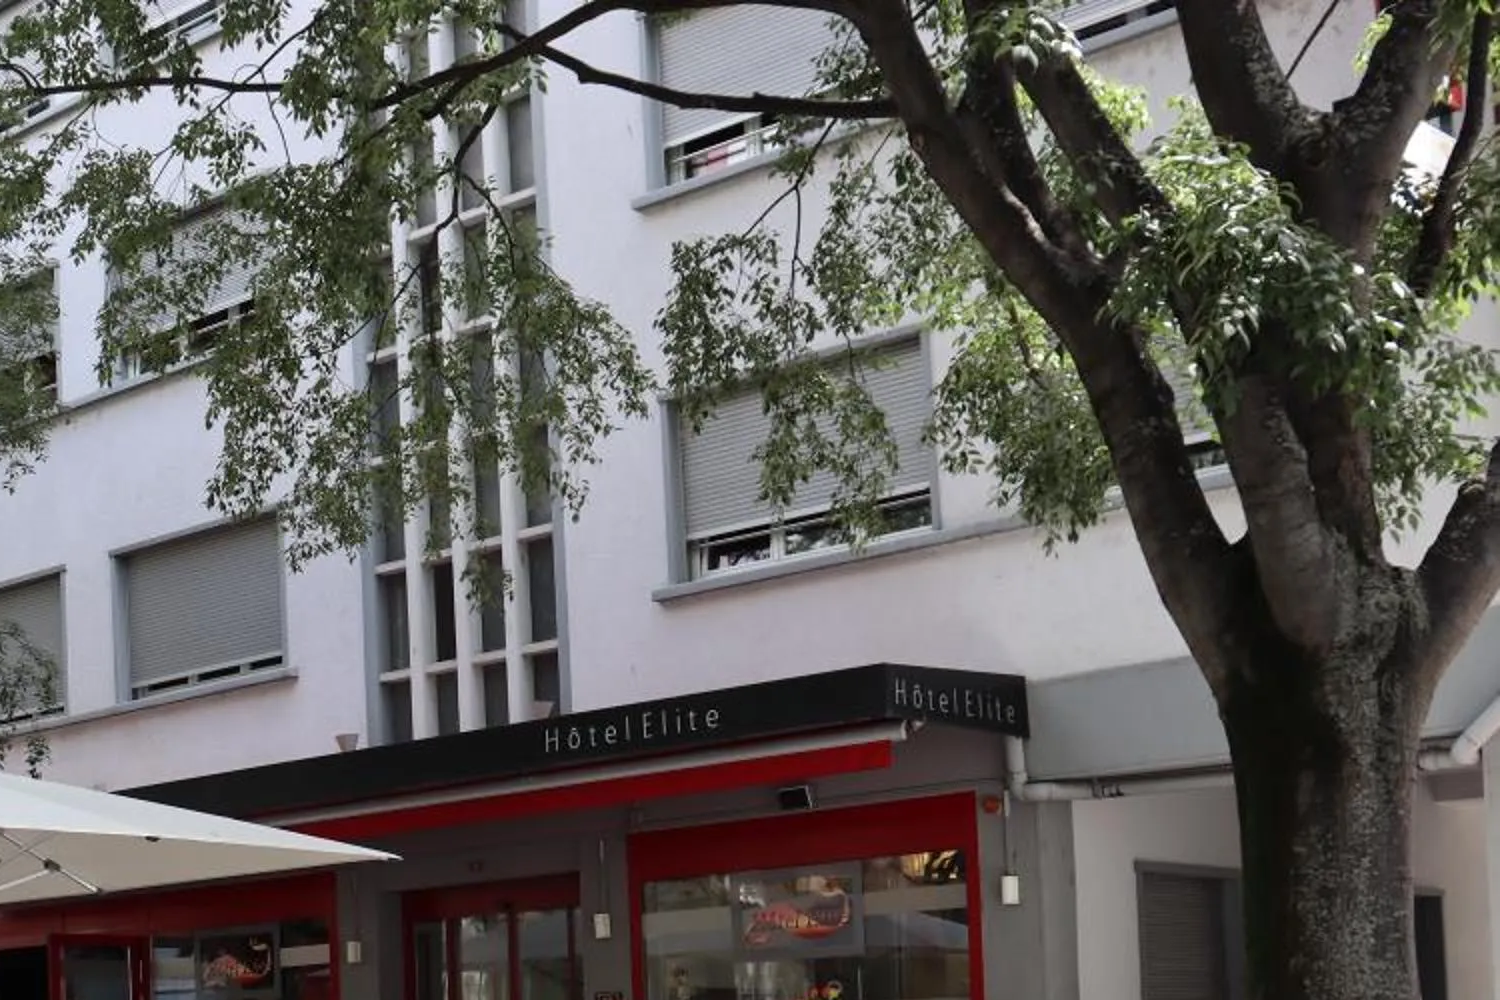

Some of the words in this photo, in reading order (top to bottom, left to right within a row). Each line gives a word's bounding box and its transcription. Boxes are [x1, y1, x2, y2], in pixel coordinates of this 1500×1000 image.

[894, 677, 959, 717] Hôtel
[964, 689, 1016, 724] Elite
[544, 714, 631, 753] Hôtel
[642, 708, 720, 739] Elite
